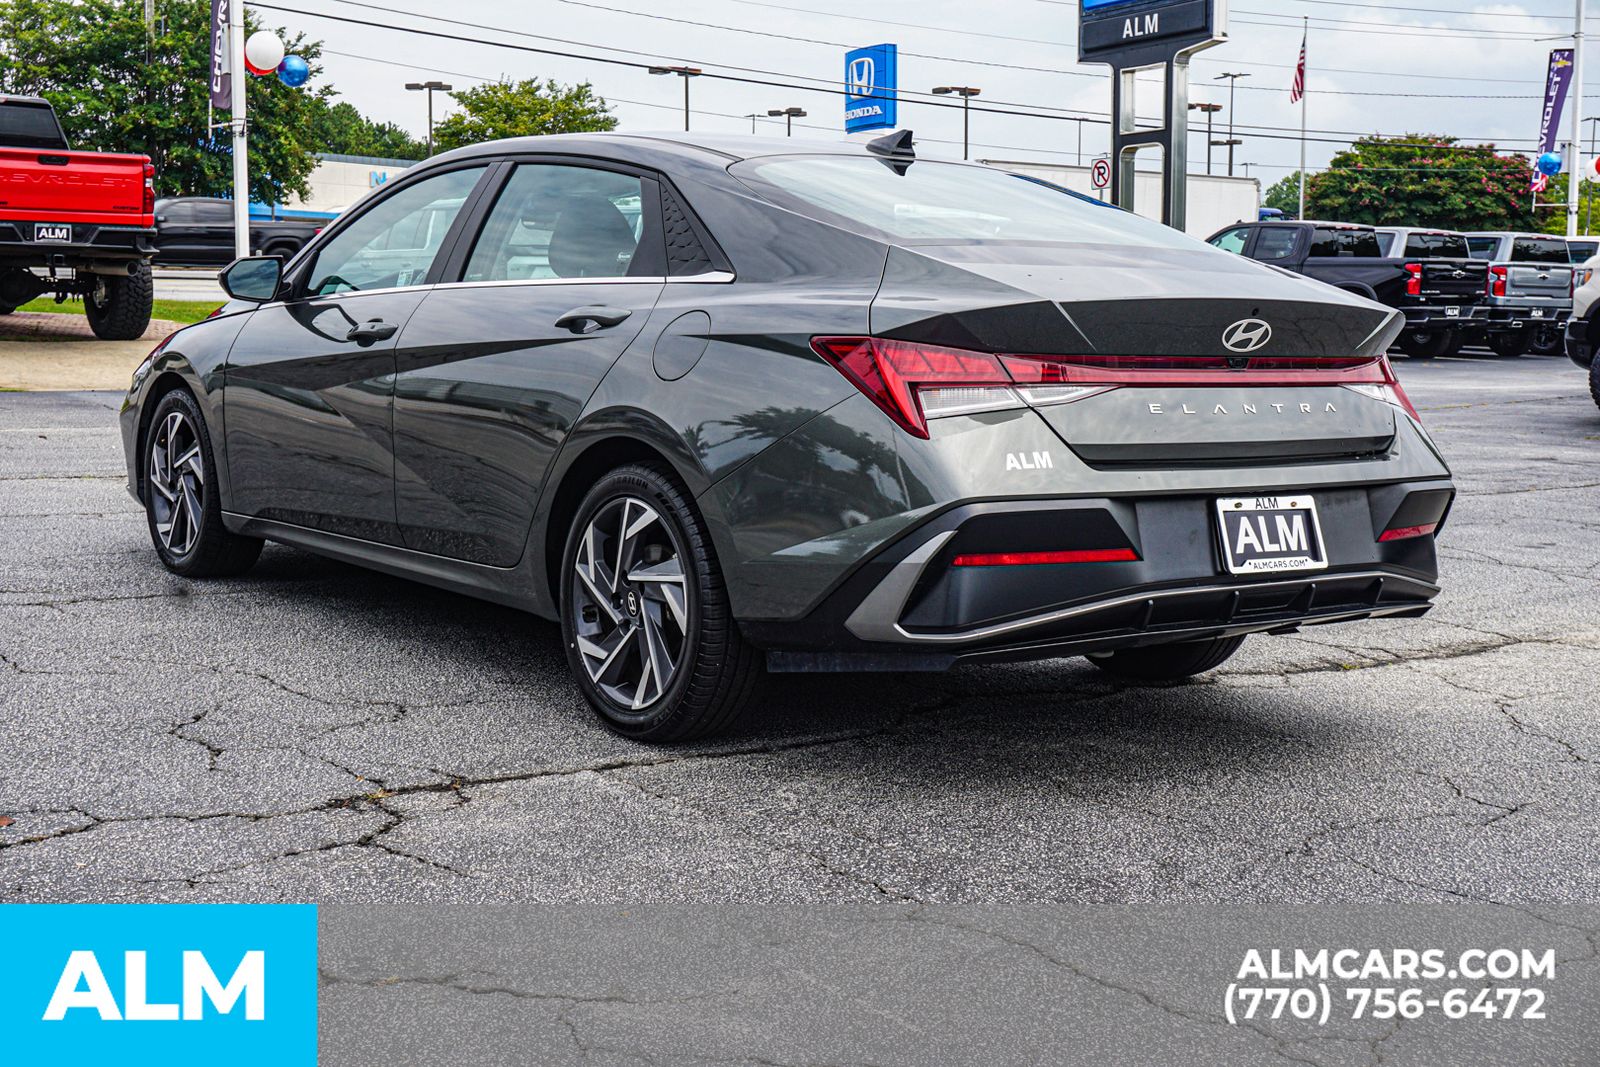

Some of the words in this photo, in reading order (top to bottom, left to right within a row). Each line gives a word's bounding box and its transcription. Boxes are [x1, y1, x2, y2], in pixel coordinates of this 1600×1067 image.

[1122, 13, 1159, 39] ALM
[844, 105, 883, 120] HONDA
[38, 228, 67, 239] ALM
[1148, 403, 1337, 415] ELANTRA
[1005, 451, 1053, 471] ALM
[1255, 497, 1279, 509] ALM
[1235, 514, 1309, 554] ALM
[1253, 559, 1306, 570] ALMCARS.COM
